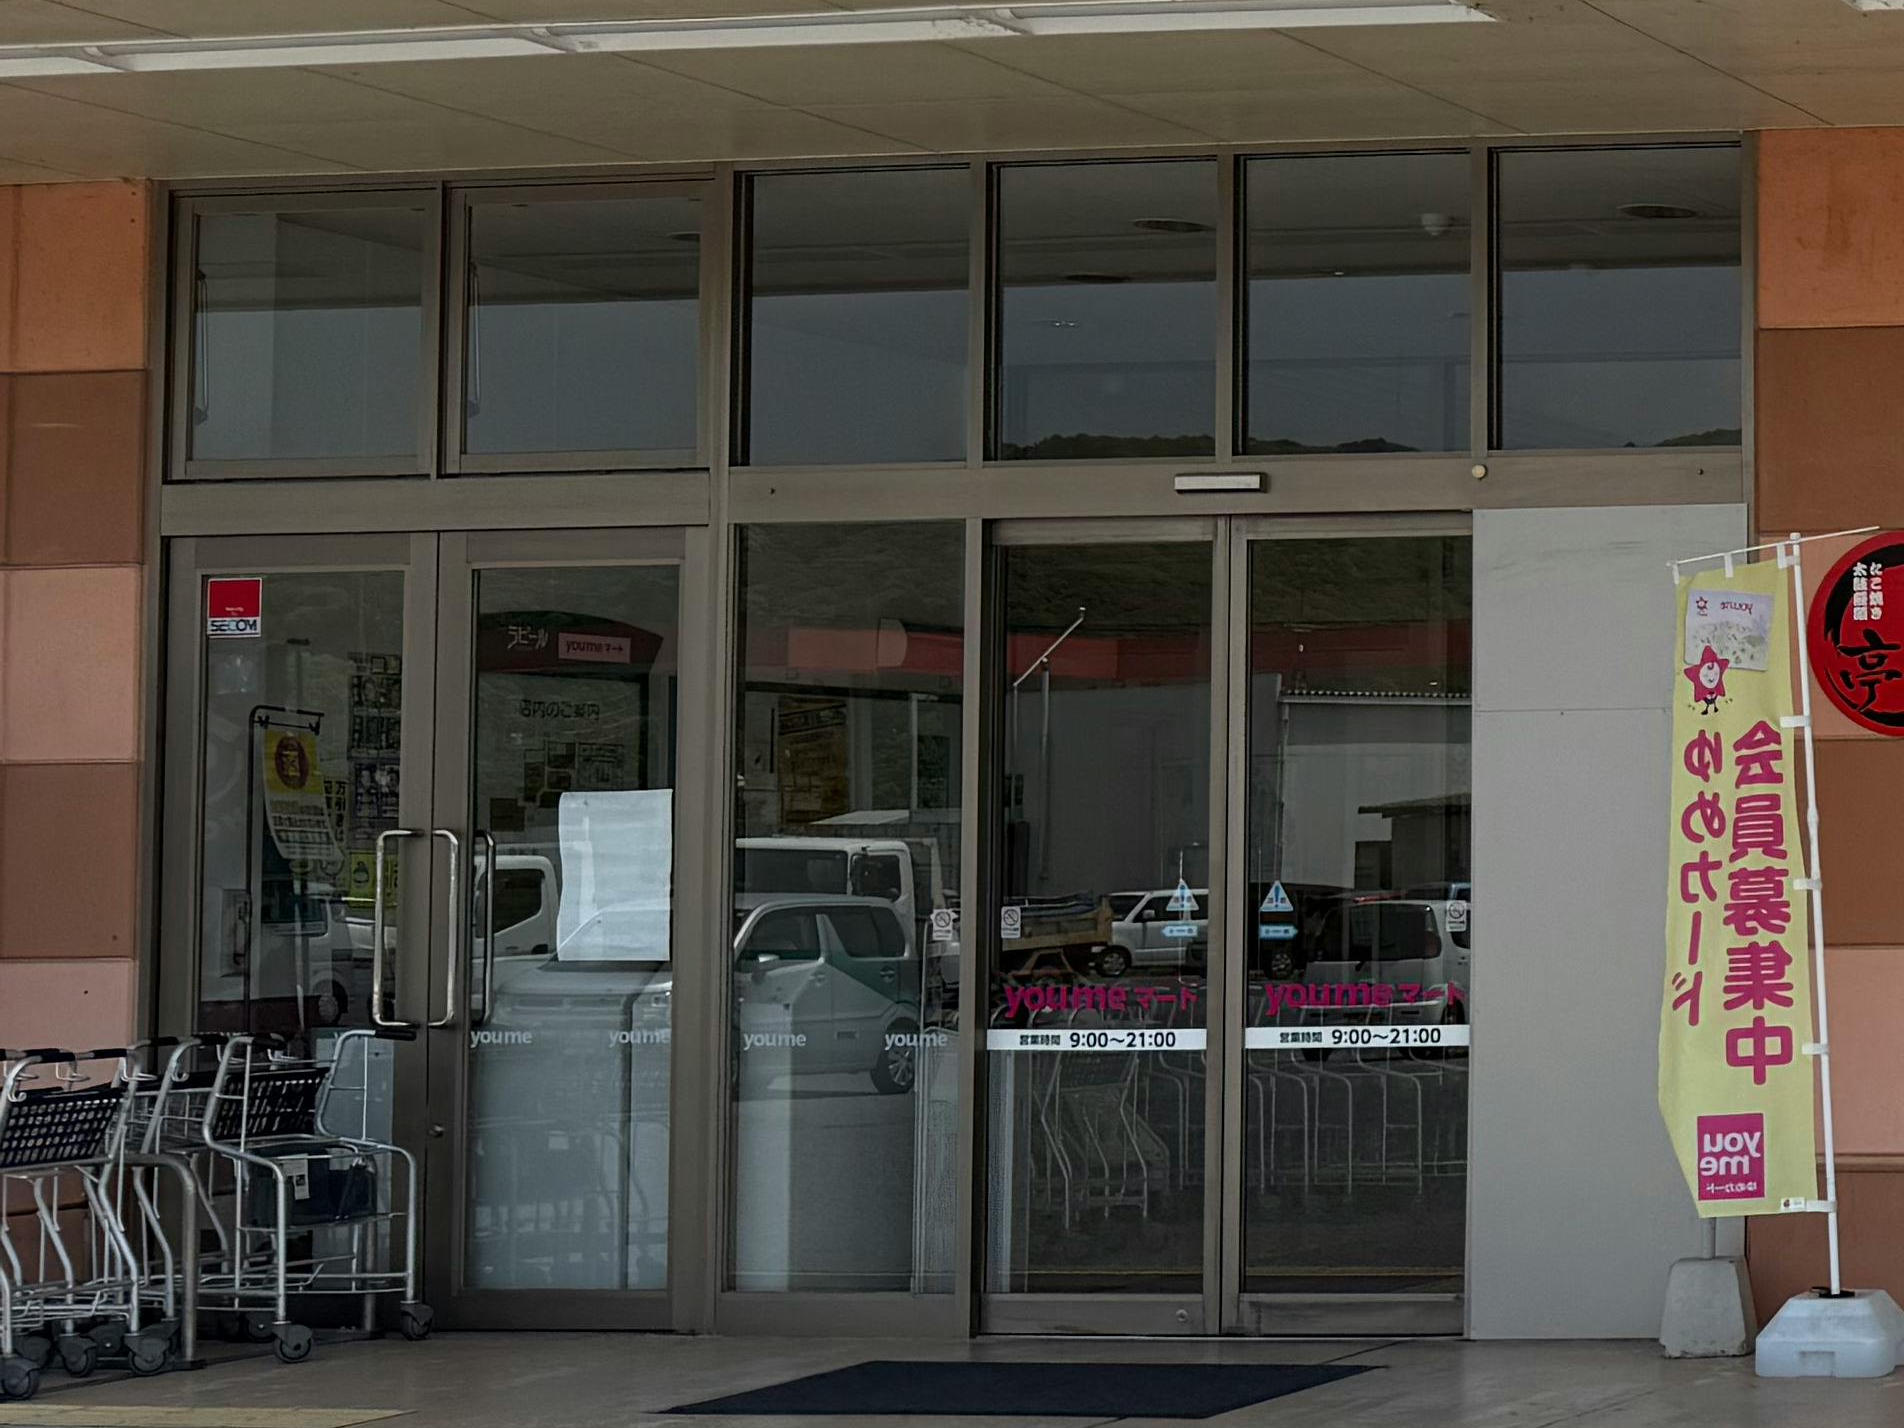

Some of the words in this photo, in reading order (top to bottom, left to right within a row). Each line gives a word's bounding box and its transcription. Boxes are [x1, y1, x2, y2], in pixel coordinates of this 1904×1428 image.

[209, 618, 258, 633] SECOM
[1005, 986, 1127, 1019] youme
[1134, 986, 1199, 1010] マート
[1265, 982, 1393, 1016] youme
[470, 1029, 533, 1046] youme
[743, 1031, 807, 1049] youme
[884, 1031, 948, 1049] youme
